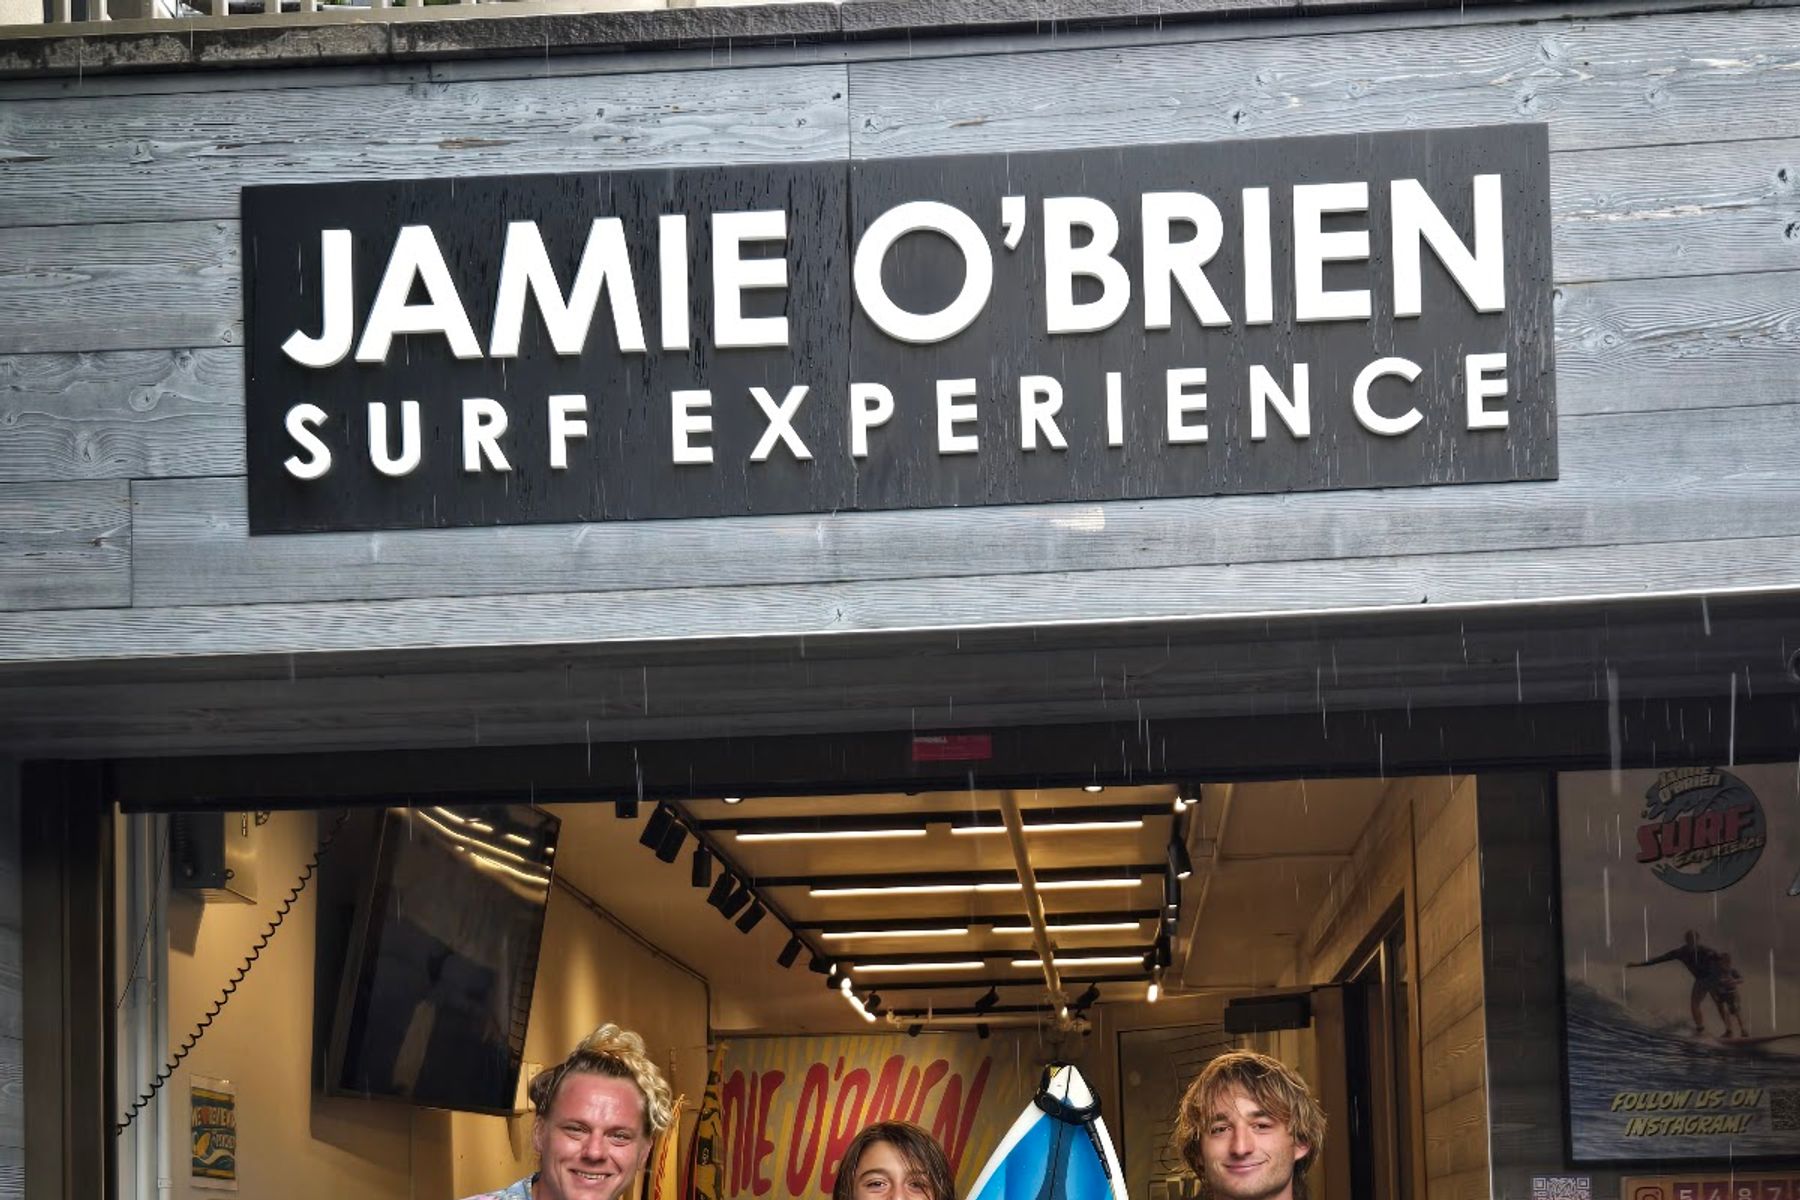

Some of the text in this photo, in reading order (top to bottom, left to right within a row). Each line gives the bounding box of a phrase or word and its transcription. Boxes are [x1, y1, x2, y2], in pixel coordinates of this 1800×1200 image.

[281, 172, 1507, 369] JAMIE O'BRIEN
[283, 351, 1510, 481] SURF EXPERIENCE
[1636, 803, 1755, 863] SURF
[1611, 1087, 1763, 1112] FOLLOW US ON
[1625, 1114, 1754, 1137] INSTAGRAM!
